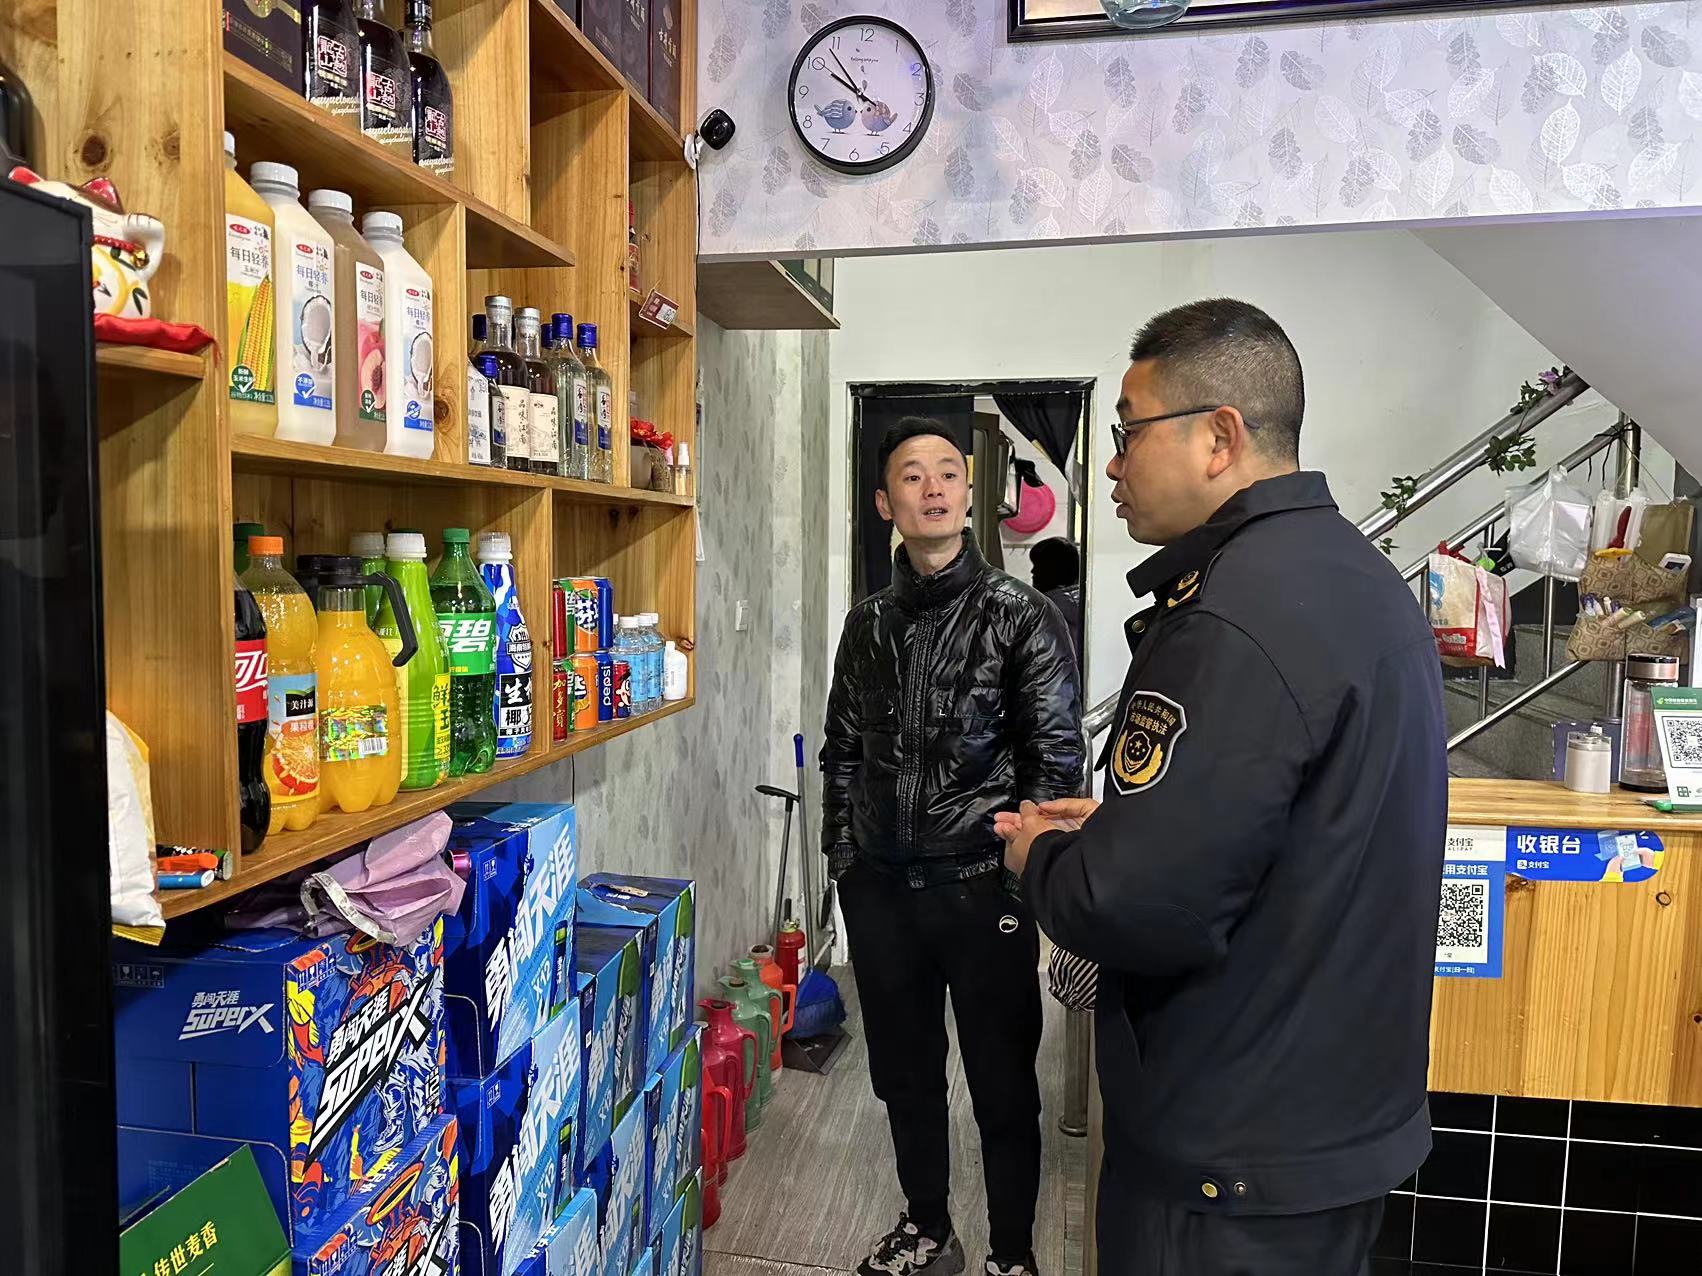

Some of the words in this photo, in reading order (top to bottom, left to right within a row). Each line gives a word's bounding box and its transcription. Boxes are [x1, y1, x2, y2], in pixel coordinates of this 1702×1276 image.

[861, 28, 875, 42] 12
[832, 36, 840, 50] 11
[807, 56, 825, 70] 10
[912, 63, 922, 77] 2
[799, 85, 809, 98] 9
[914, 93, 925, 106] 3
[803, 115, 812, 128] 8
[903, 122, 912, 134] 4
[820, 138, 830, 151] 7
[880, 142, 890, 155] 5
[849, 148, 859, 161] 6
[601, 665, 612, 706] pepsi
[290, 698, 315, 712] 美汁源
[1447, 837, 1474, 847] 支付宝
[1517, 835, 1581, 854] 收银台
[1442, 864, 1488, 876] 用支付宝
[1527, 861, 1550, 869] 支付宝
[192, 990, 240, 1008] 勇闯天涯
[326, 985, 390, 1068] 勇闯天涯
[143, 1221, 218, 1276] 传世麦香
